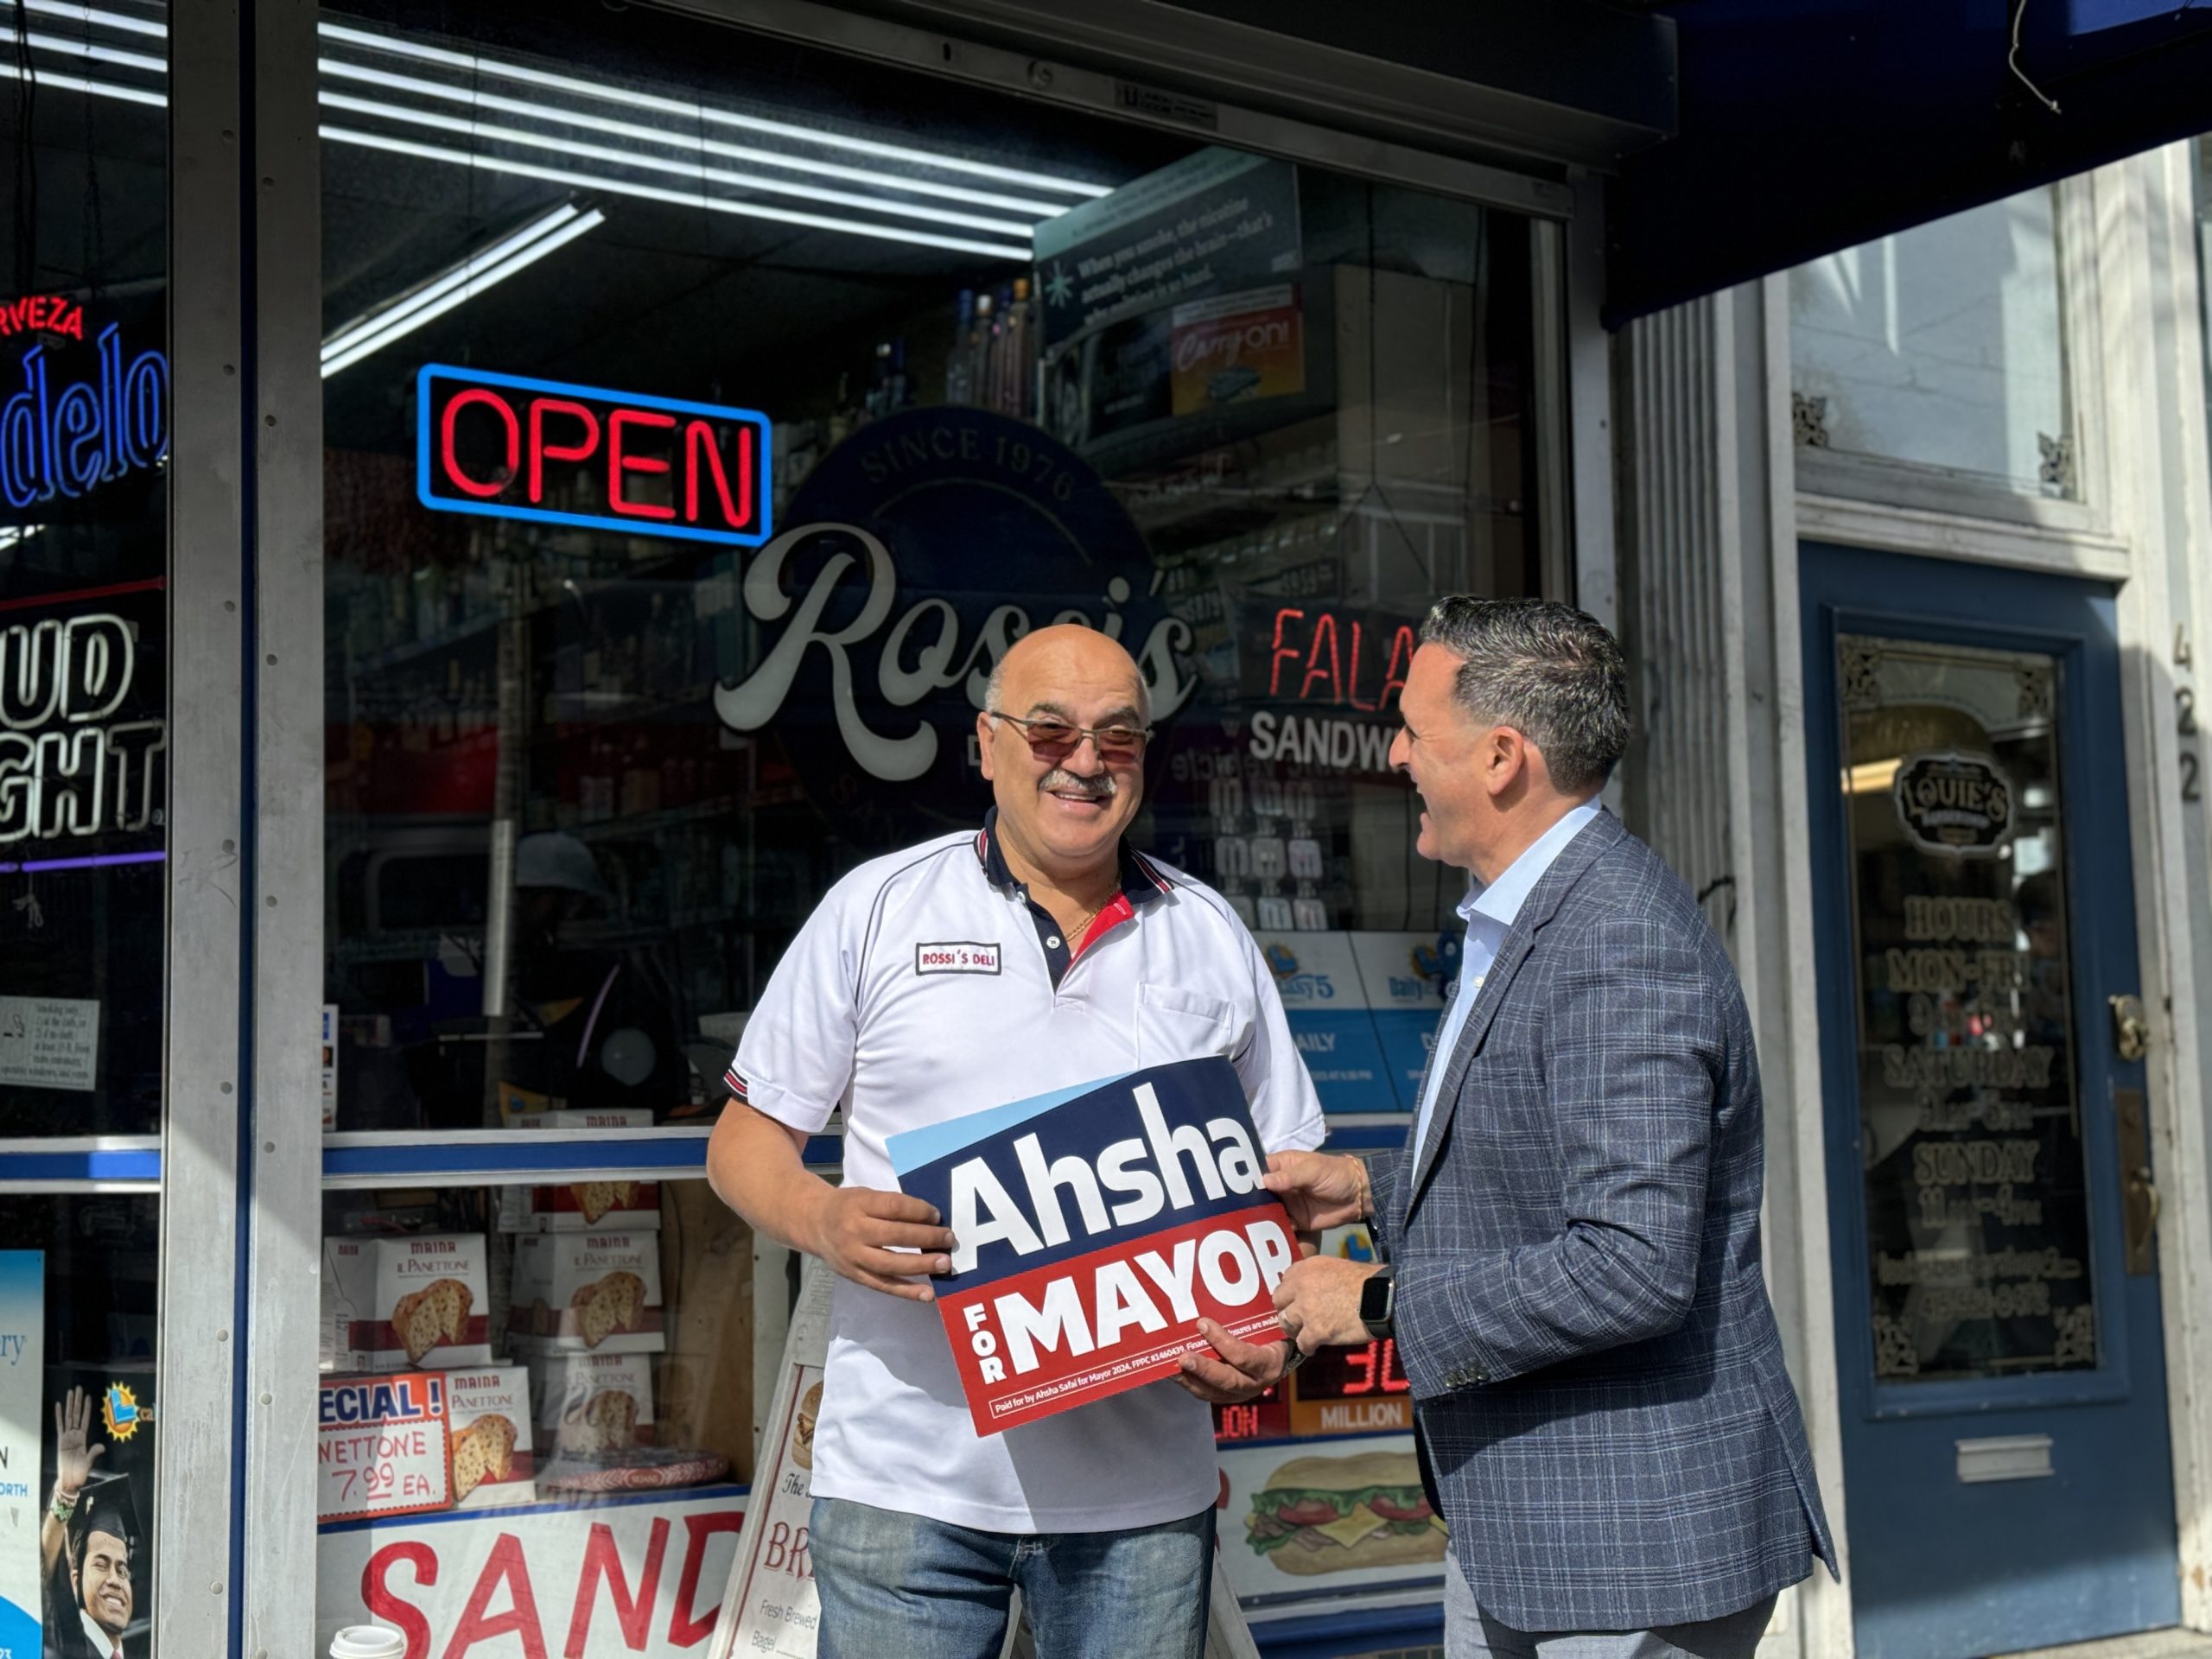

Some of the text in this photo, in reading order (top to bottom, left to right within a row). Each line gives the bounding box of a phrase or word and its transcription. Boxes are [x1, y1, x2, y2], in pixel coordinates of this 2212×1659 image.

[442, 389, 752, 528] OPEN
[861, 426, 1077, 502] SINCE 1976
[1902, 776, 2008, 823] LOUIE'S
[1903, 895, 2015, 940] HOURS
[922, 949, 995, 966] ROSSI'S DELI
[950, 1082, 1269, 1275] Ahsha
[1911, 1139, 2042, 1186] SUNDAY
[410, 1241, 457, 1255] MAINA
[994, 1219, 1294, 1376] MAYOR
[963, 1301, 1007, 1386] FOR
[454, 1375, 500, 1390] MAINA
[995, 1400, 1013, 1414] Paid
[1013, 1396, 1025, 1408] for
[1024, 1394, 1035, 1404] by
[1035, 1387, 1059, 1401] Ahsha
[1077, 1376, 1089, 1386] for
[1089, 1369, 1112, 1382] Mayor
[1131, 1356, 1151, 1369] FPPC
[1251, 1319, 1263, 1331] are
[451, 1394, 514, 1409] PANETTONE
[1320, 1402, 1403, 1430] MILLION
[332, 1462, 436, 1502] 7.99 EA.
[782, 1472, 805, 1497] The
[763, 1522, 816, 1583] BR
[760, 1599, 817, 1630] Fresh Brewed
[751, 1630, 778, 1654] Bagel
